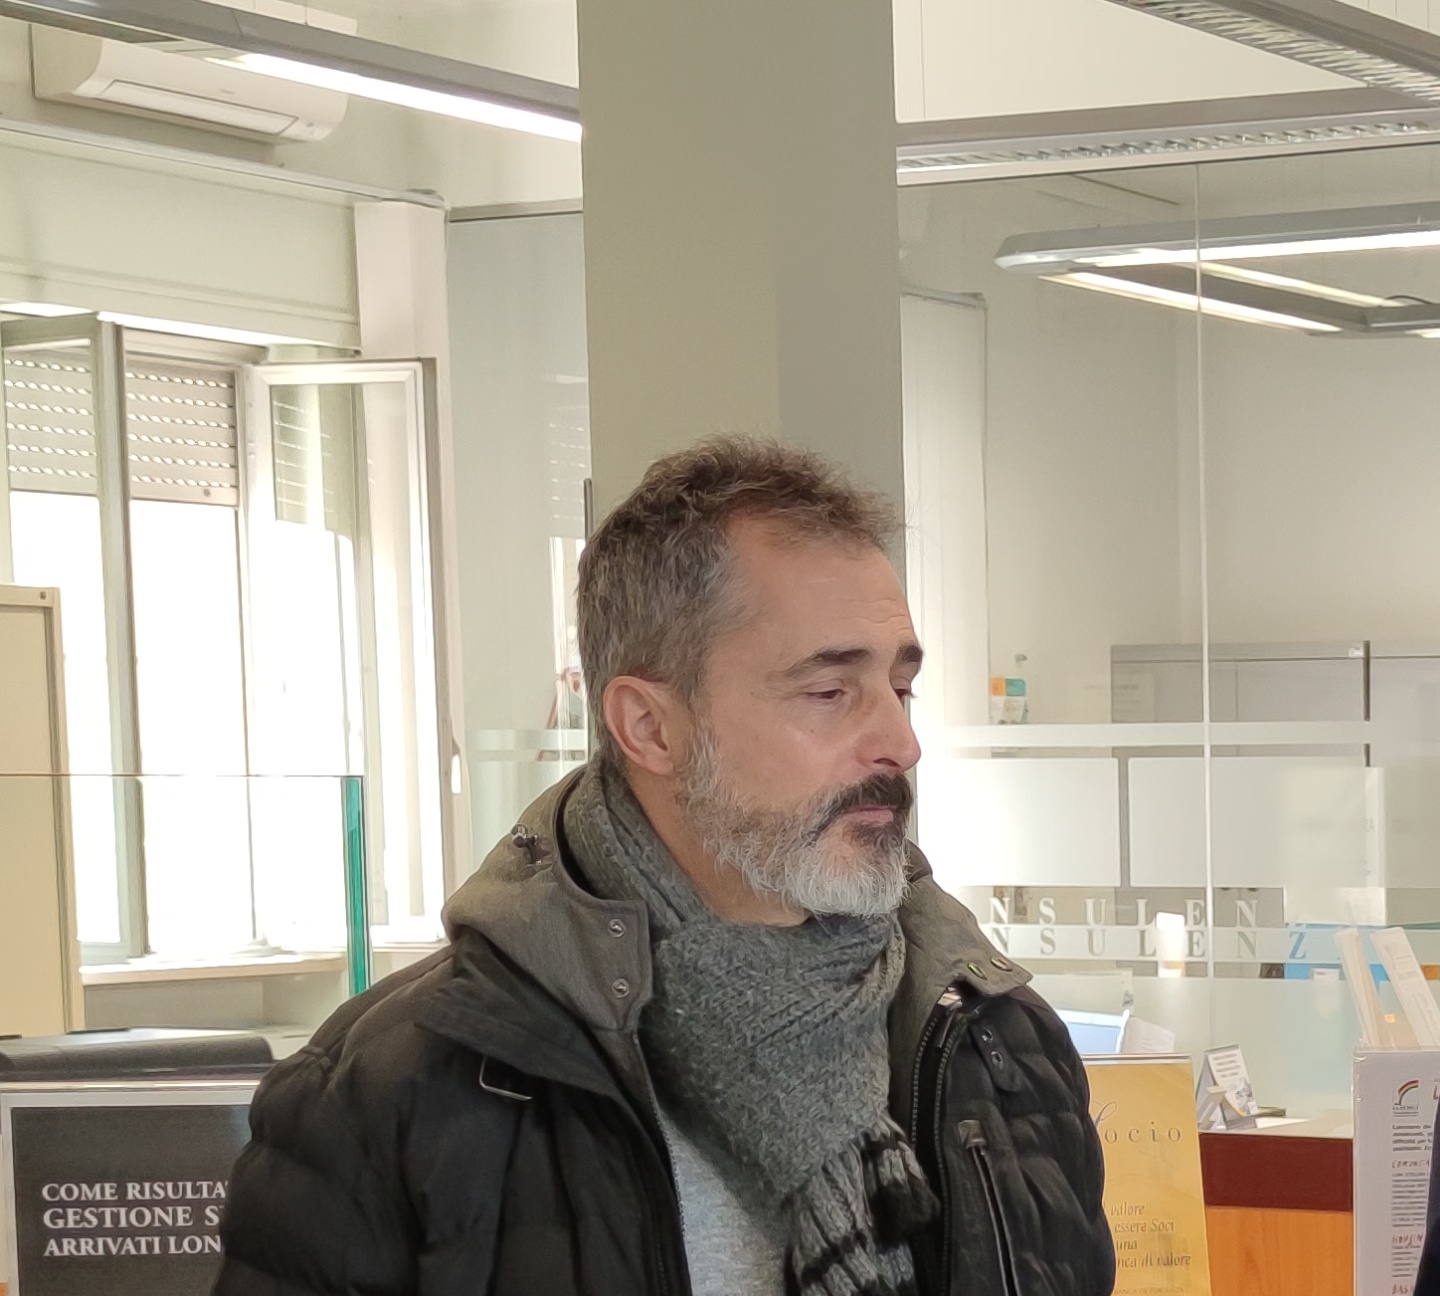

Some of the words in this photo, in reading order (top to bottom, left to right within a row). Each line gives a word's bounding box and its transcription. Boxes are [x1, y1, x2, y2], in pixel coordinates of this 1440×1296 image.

[41, 1182, 119, 1202] COME
[126, 1180, 229, 1201] RISULTA
[43, 1206, 194, 1229] GESTIONE
[204, 1204, 225, 1227] S
[43, 1235, 162, 1257] ARRIVATI
[167, 1234, 223, 1255] LON
